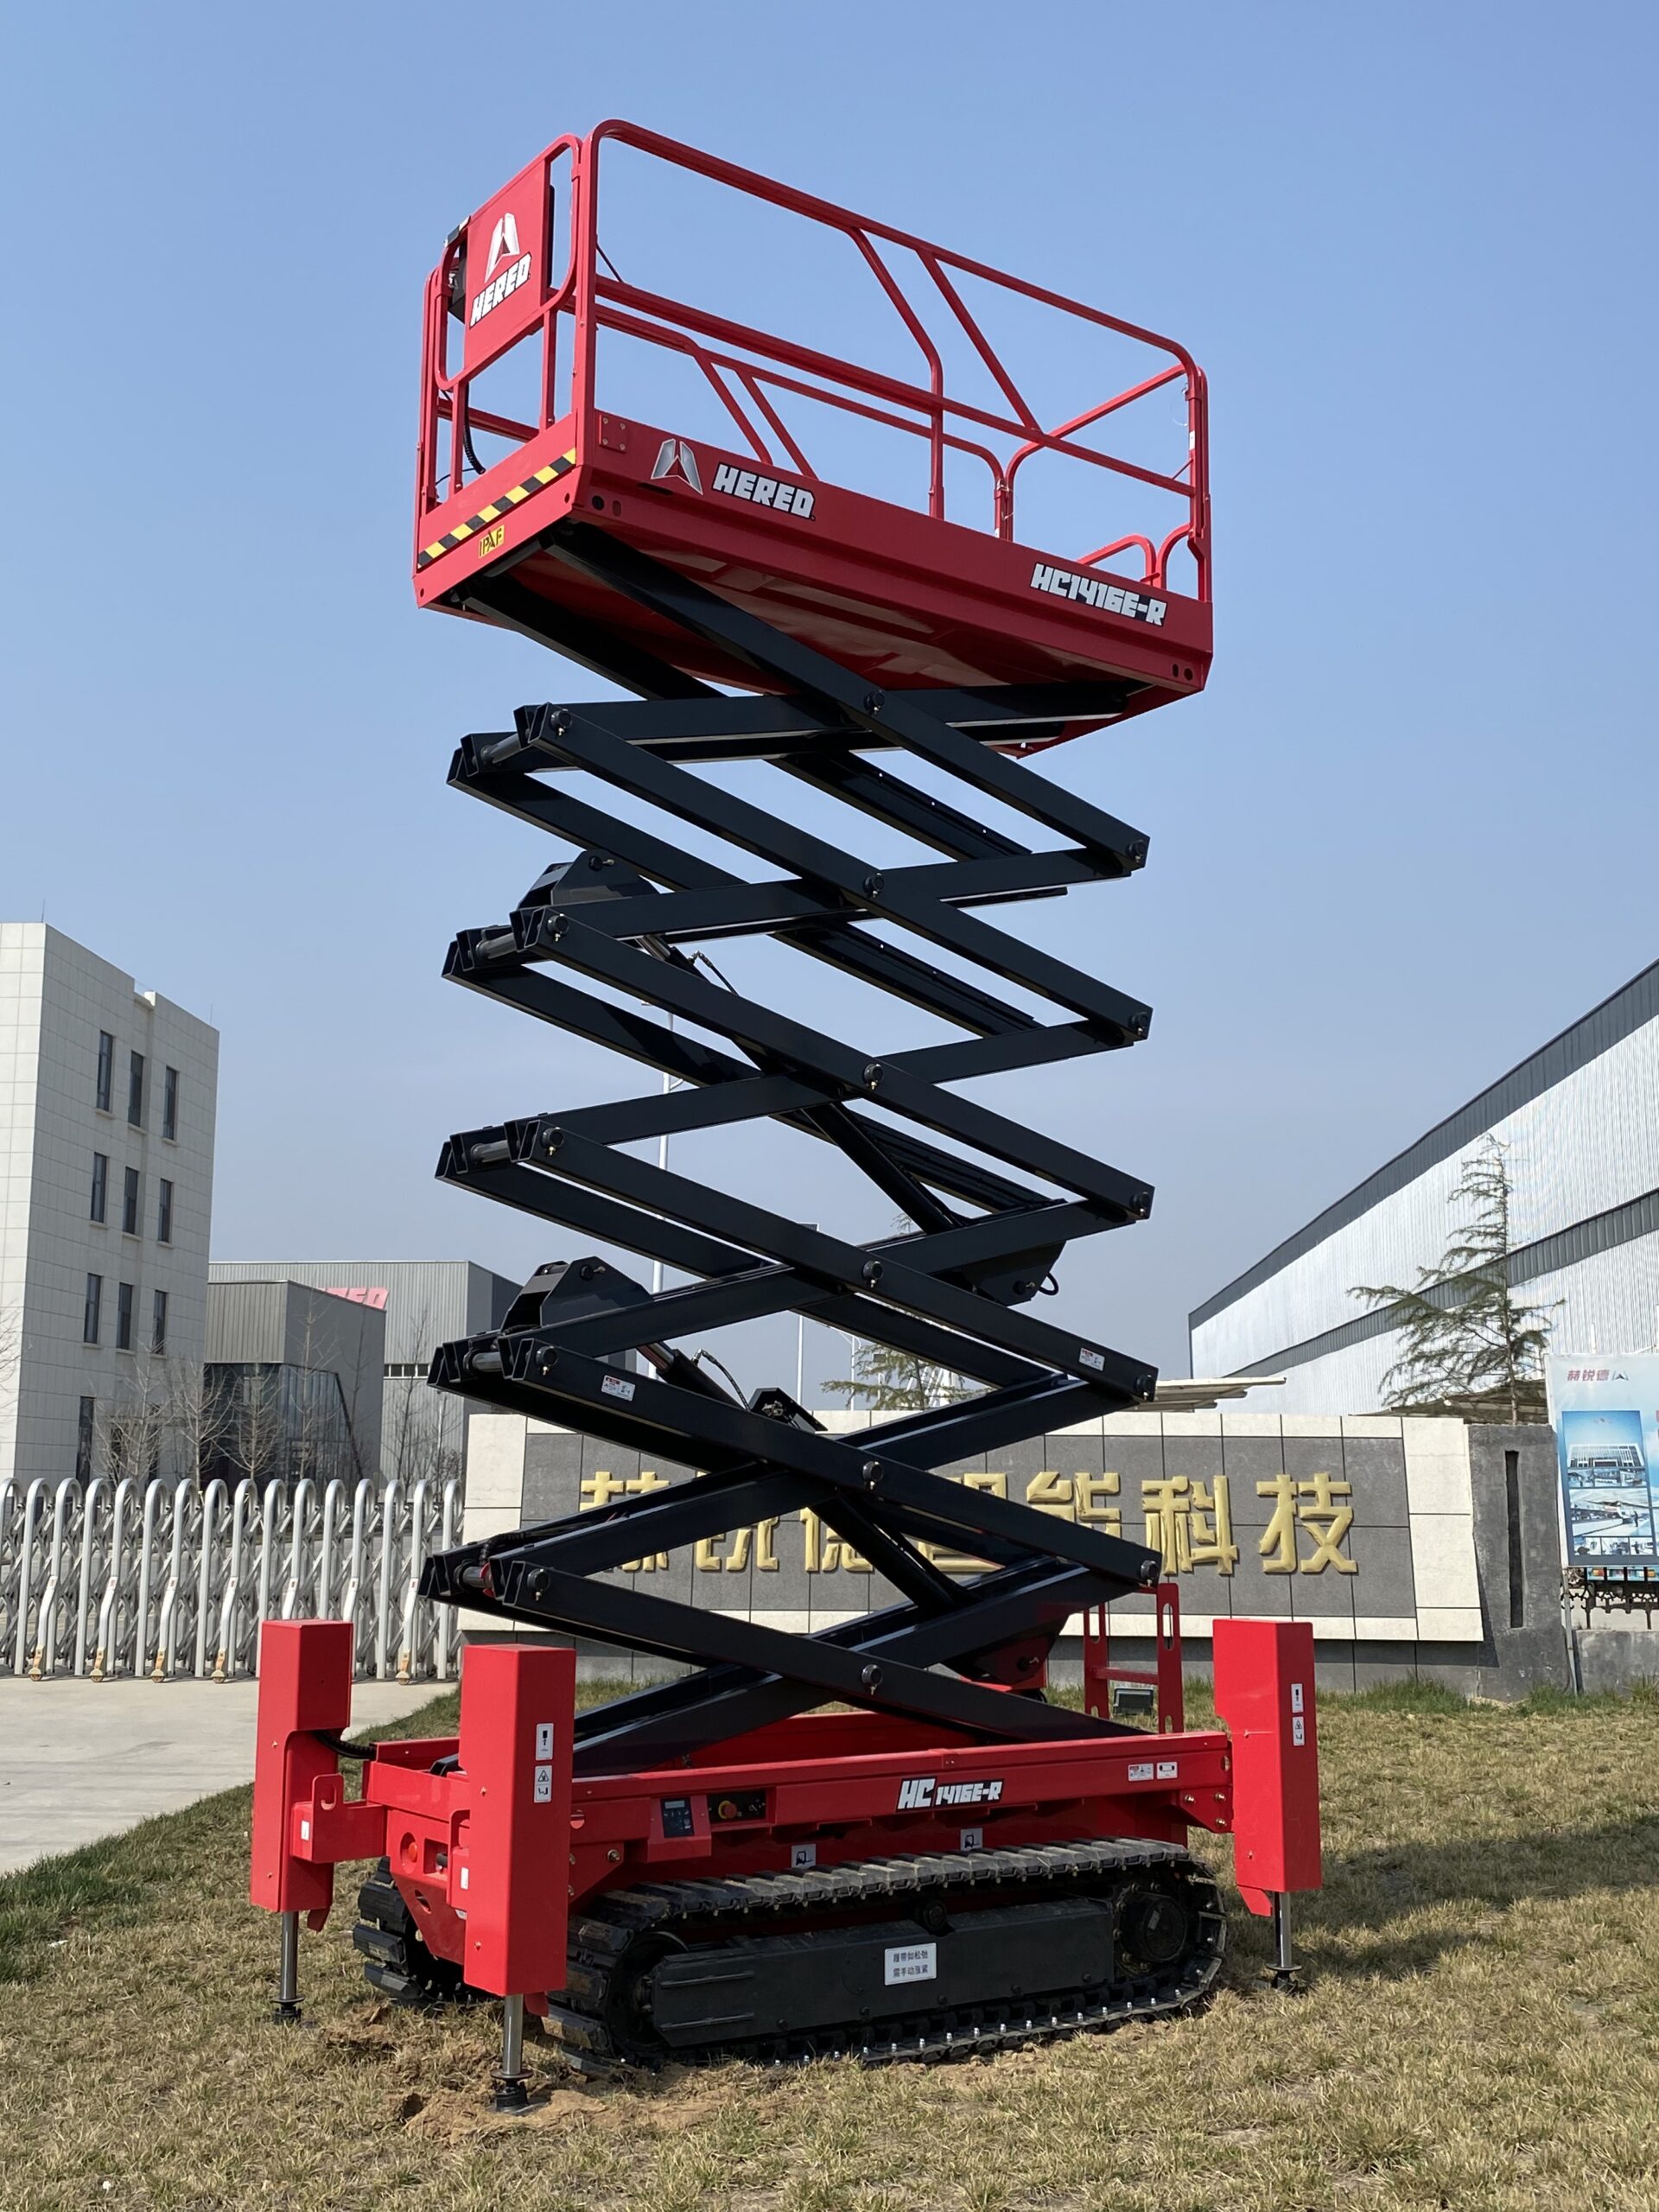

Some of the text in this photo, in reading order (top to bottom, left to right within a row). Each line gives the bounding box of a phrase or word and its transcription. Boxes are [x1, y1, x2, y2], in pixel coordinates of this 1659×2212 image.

[469, 252, 531, 328] HERED
[712, 463, 815, 519] HERED
[479, 527, 503, 557] IPAF
[1030, 563, 1167, 626] HC1416E-R
[1567, 1369, 1610, 1382] 赫锐德
